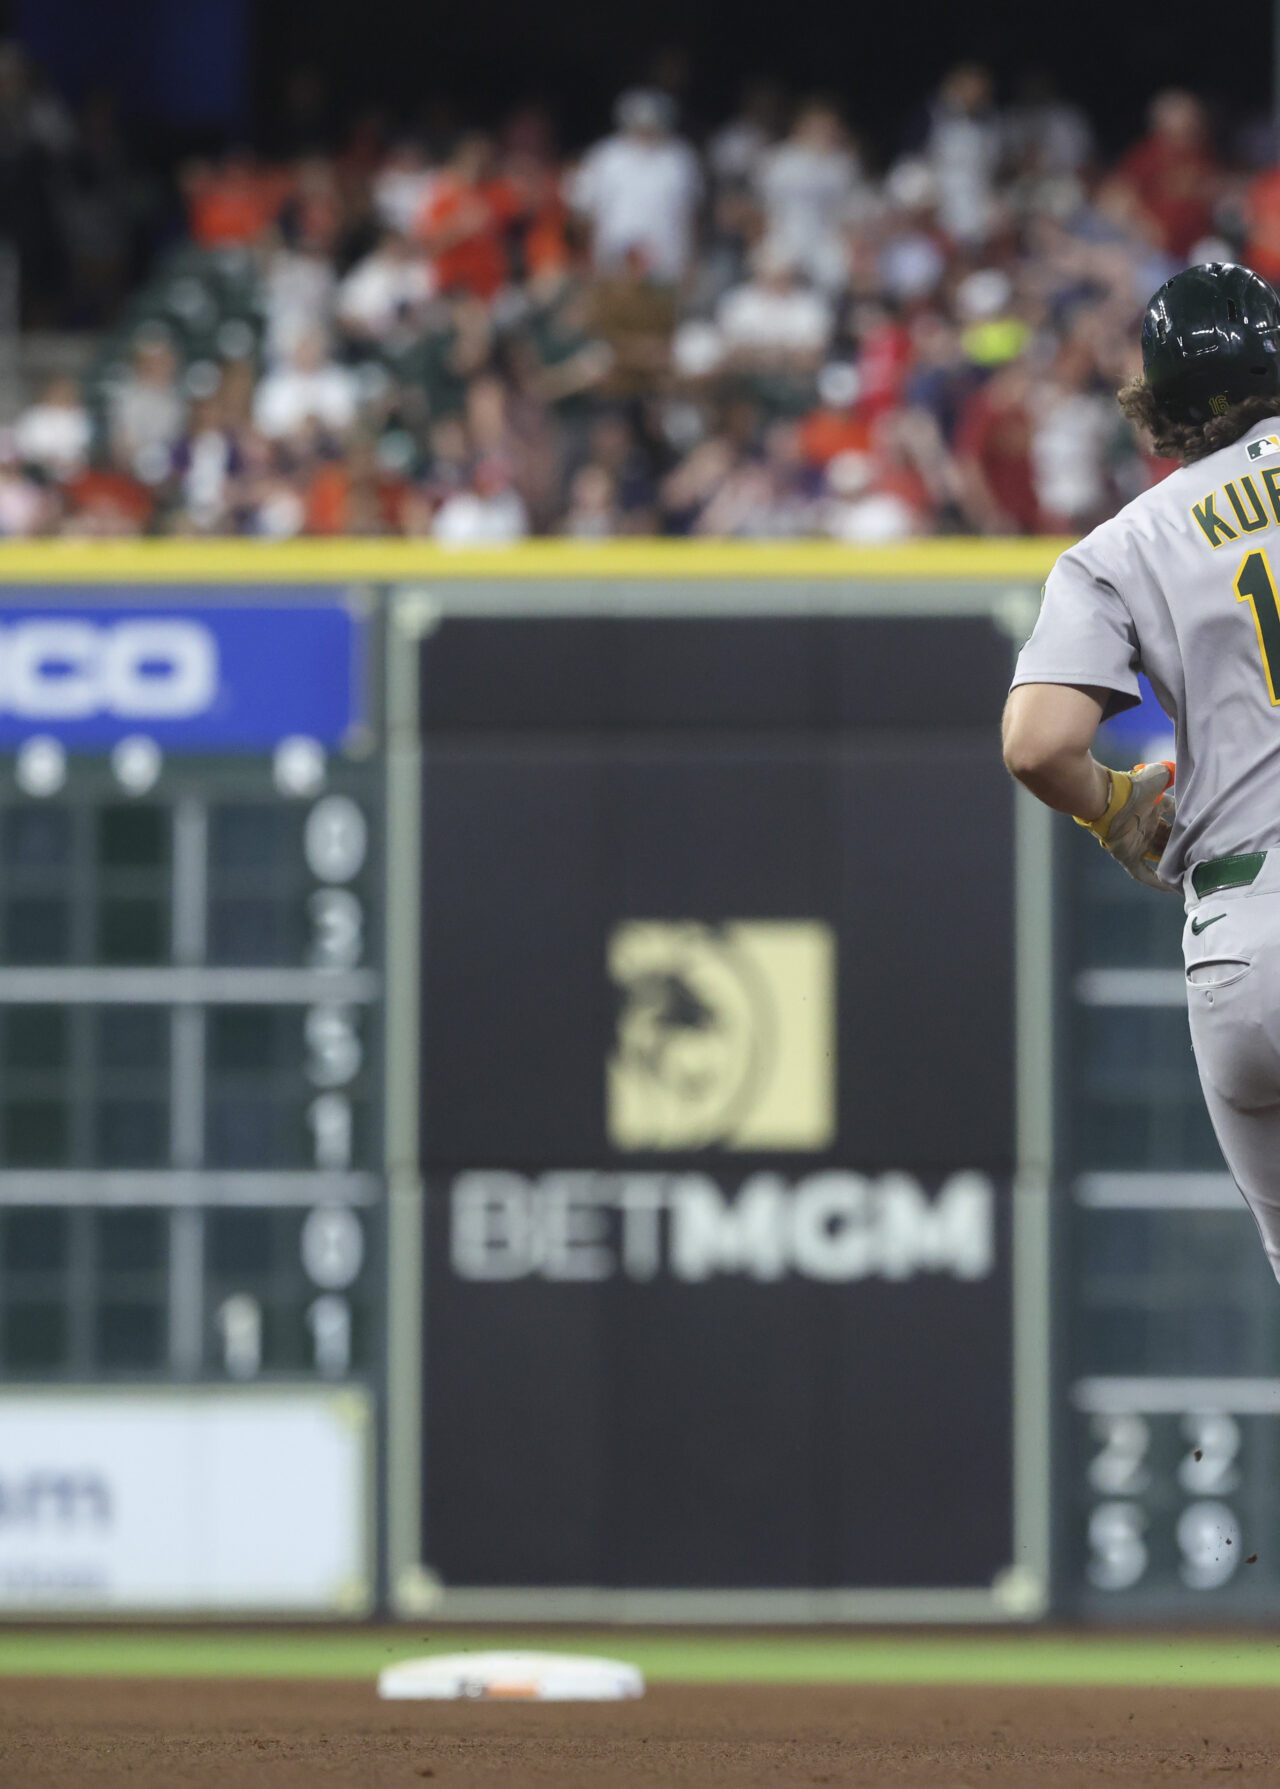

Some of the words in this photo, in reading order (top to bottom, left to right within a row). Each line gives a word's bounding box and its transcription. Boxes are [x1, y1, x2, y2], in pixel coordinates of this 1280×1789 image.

[1208, 395, 1229, 416] 16
[0, 617, 218, 721] CO
[450, 1169, 993, 1282] BETMGM
